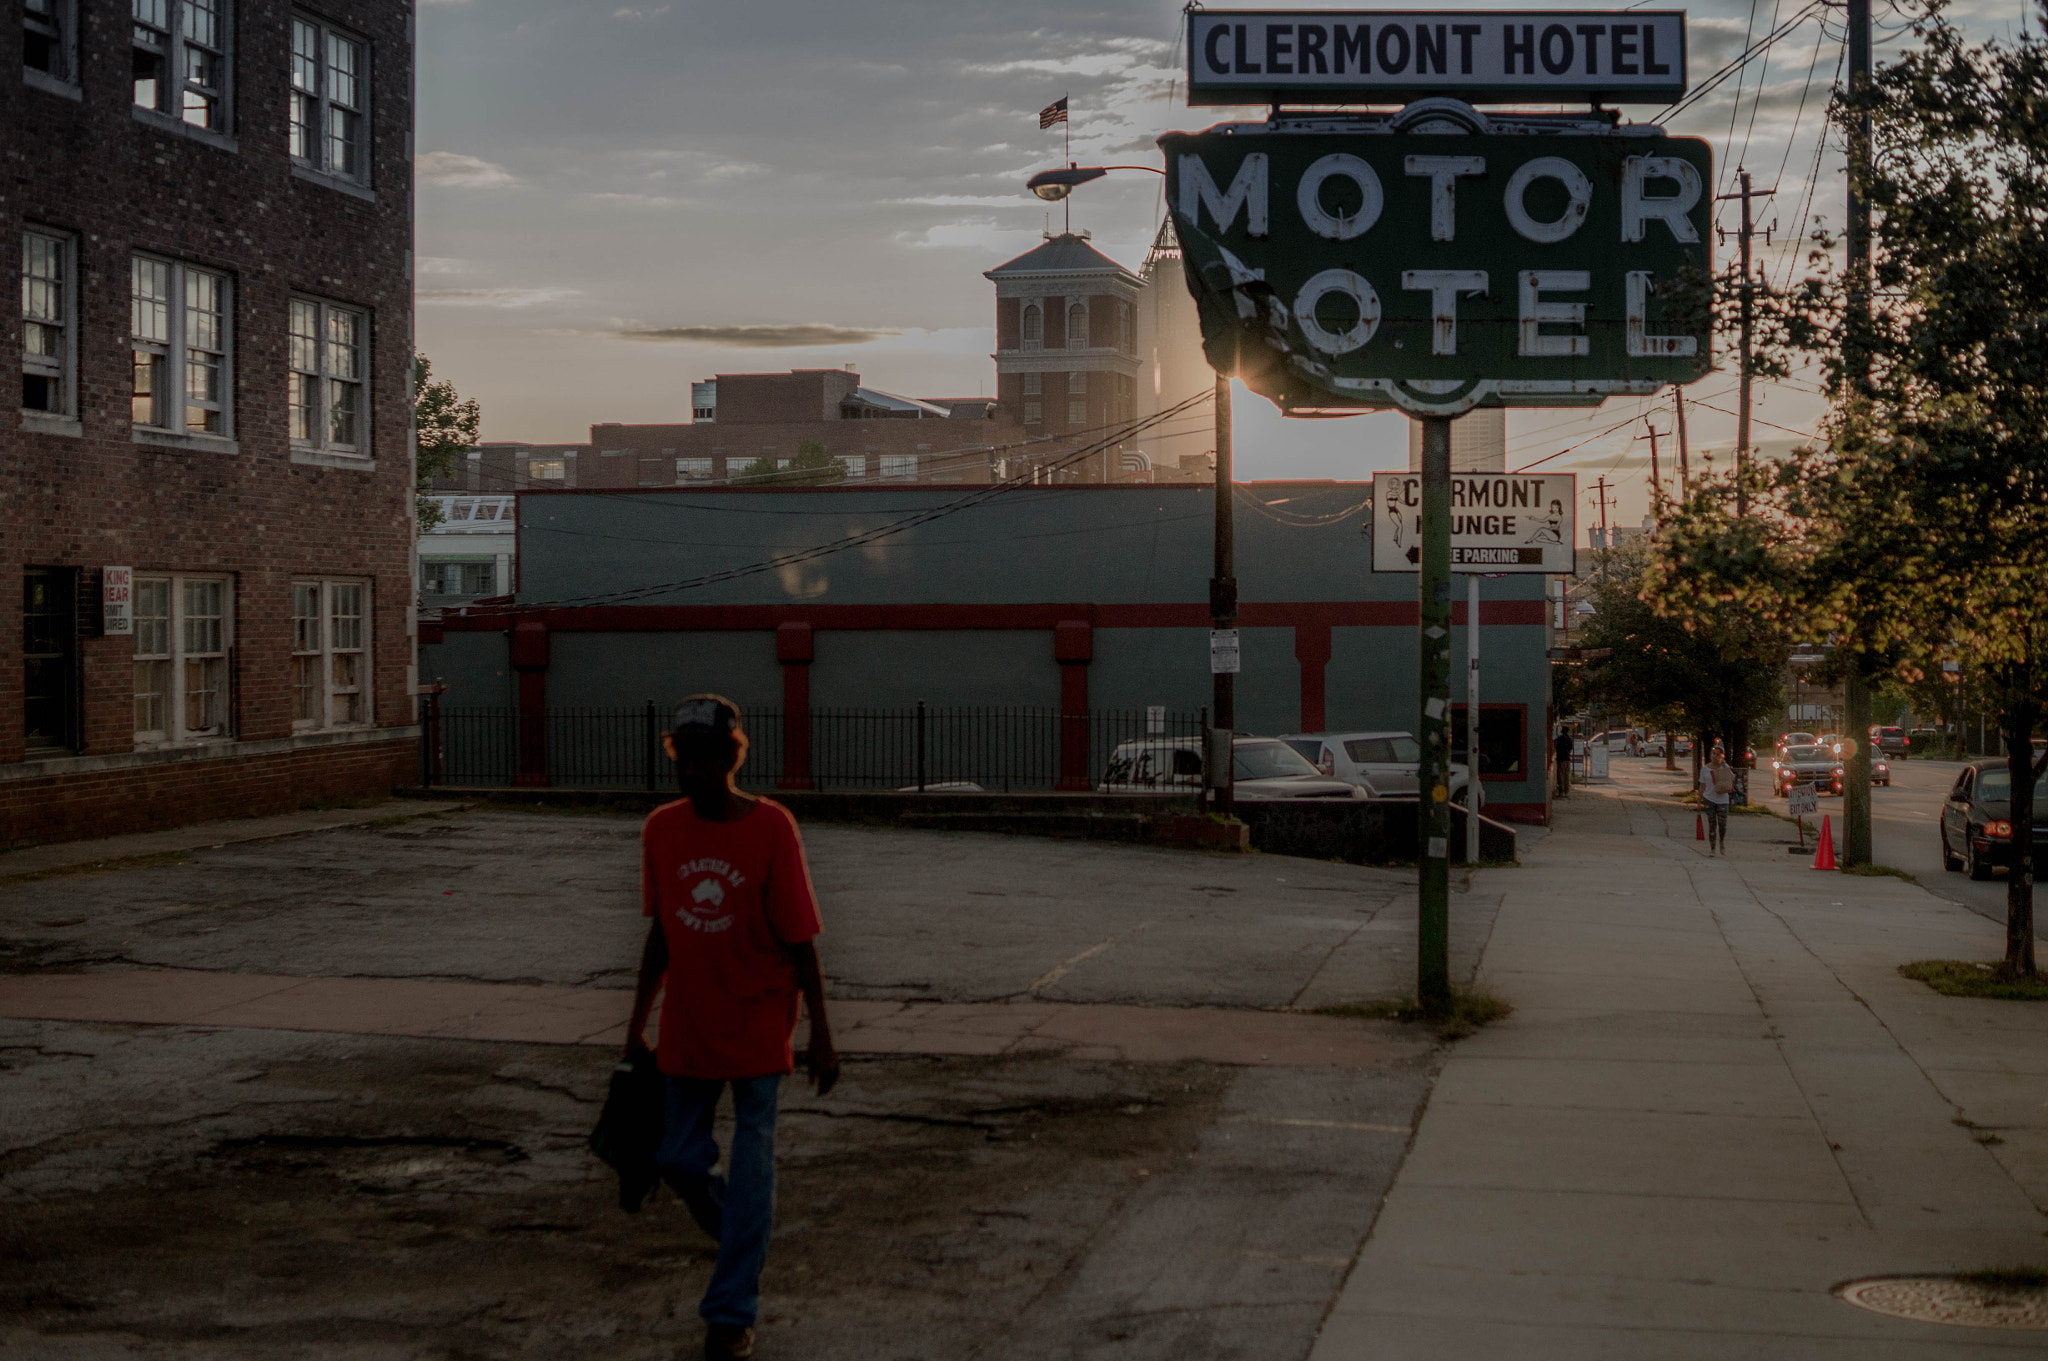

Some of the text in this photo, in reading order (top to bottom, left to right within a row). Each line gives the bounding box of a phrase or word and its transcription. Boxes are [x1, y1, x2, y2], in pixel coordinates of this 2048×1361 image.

[1204, 23, 1671, 76] CLERMONT HOTEL
[1177, 151, 1702, 244] MOTOR
[1404, 479, 1545, 508] CRMONT
[1416, 515, 1516, 535] UNGE
[1463, 548, 1519, 564] PARKING
[105, 570, 129, 585] KING
